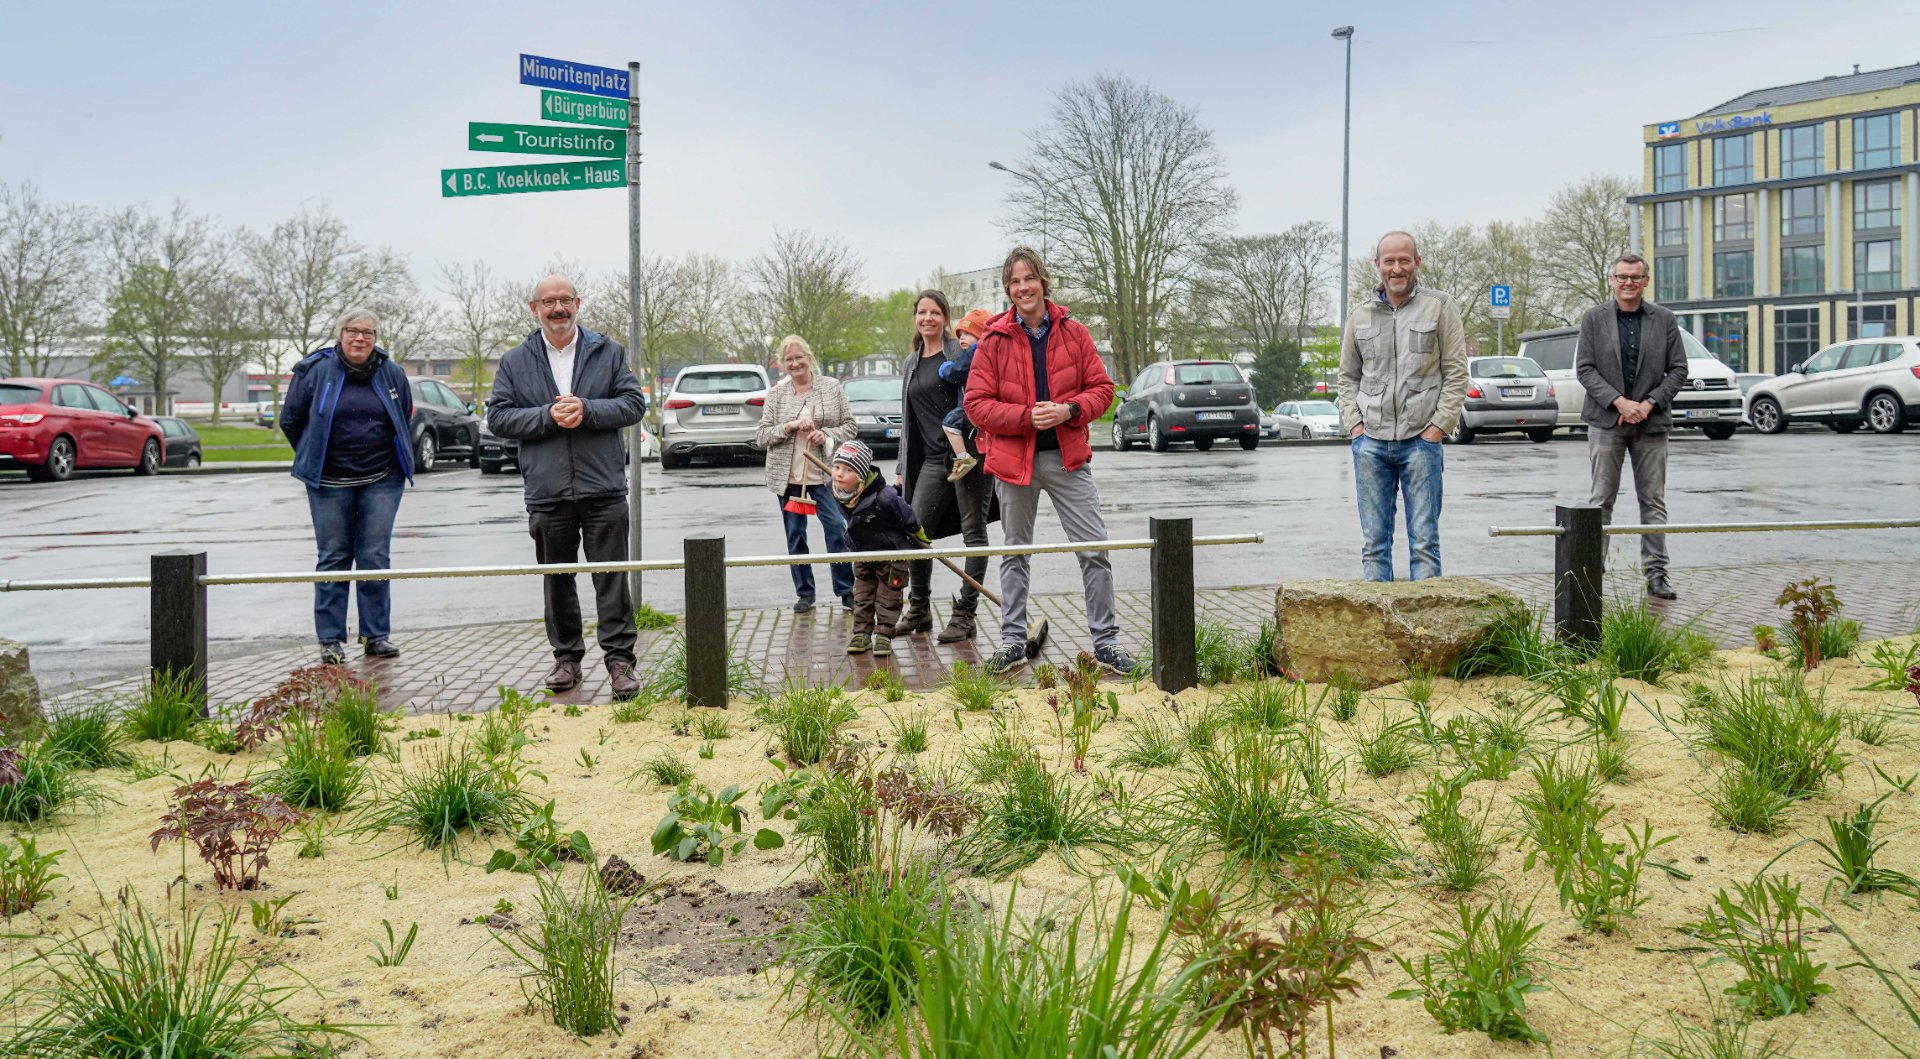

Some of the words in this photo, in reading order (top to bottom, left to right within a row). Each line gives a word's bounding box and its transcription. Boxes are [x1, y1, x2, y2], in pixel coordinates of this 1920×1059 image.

[523, 57, 627, 91] Minoritenplatz
[554, 95, 626, 121] Bürgerbüro
[514, 130, 615, 151] Touristinfo
[463, 172, 490, 191] B.C.
